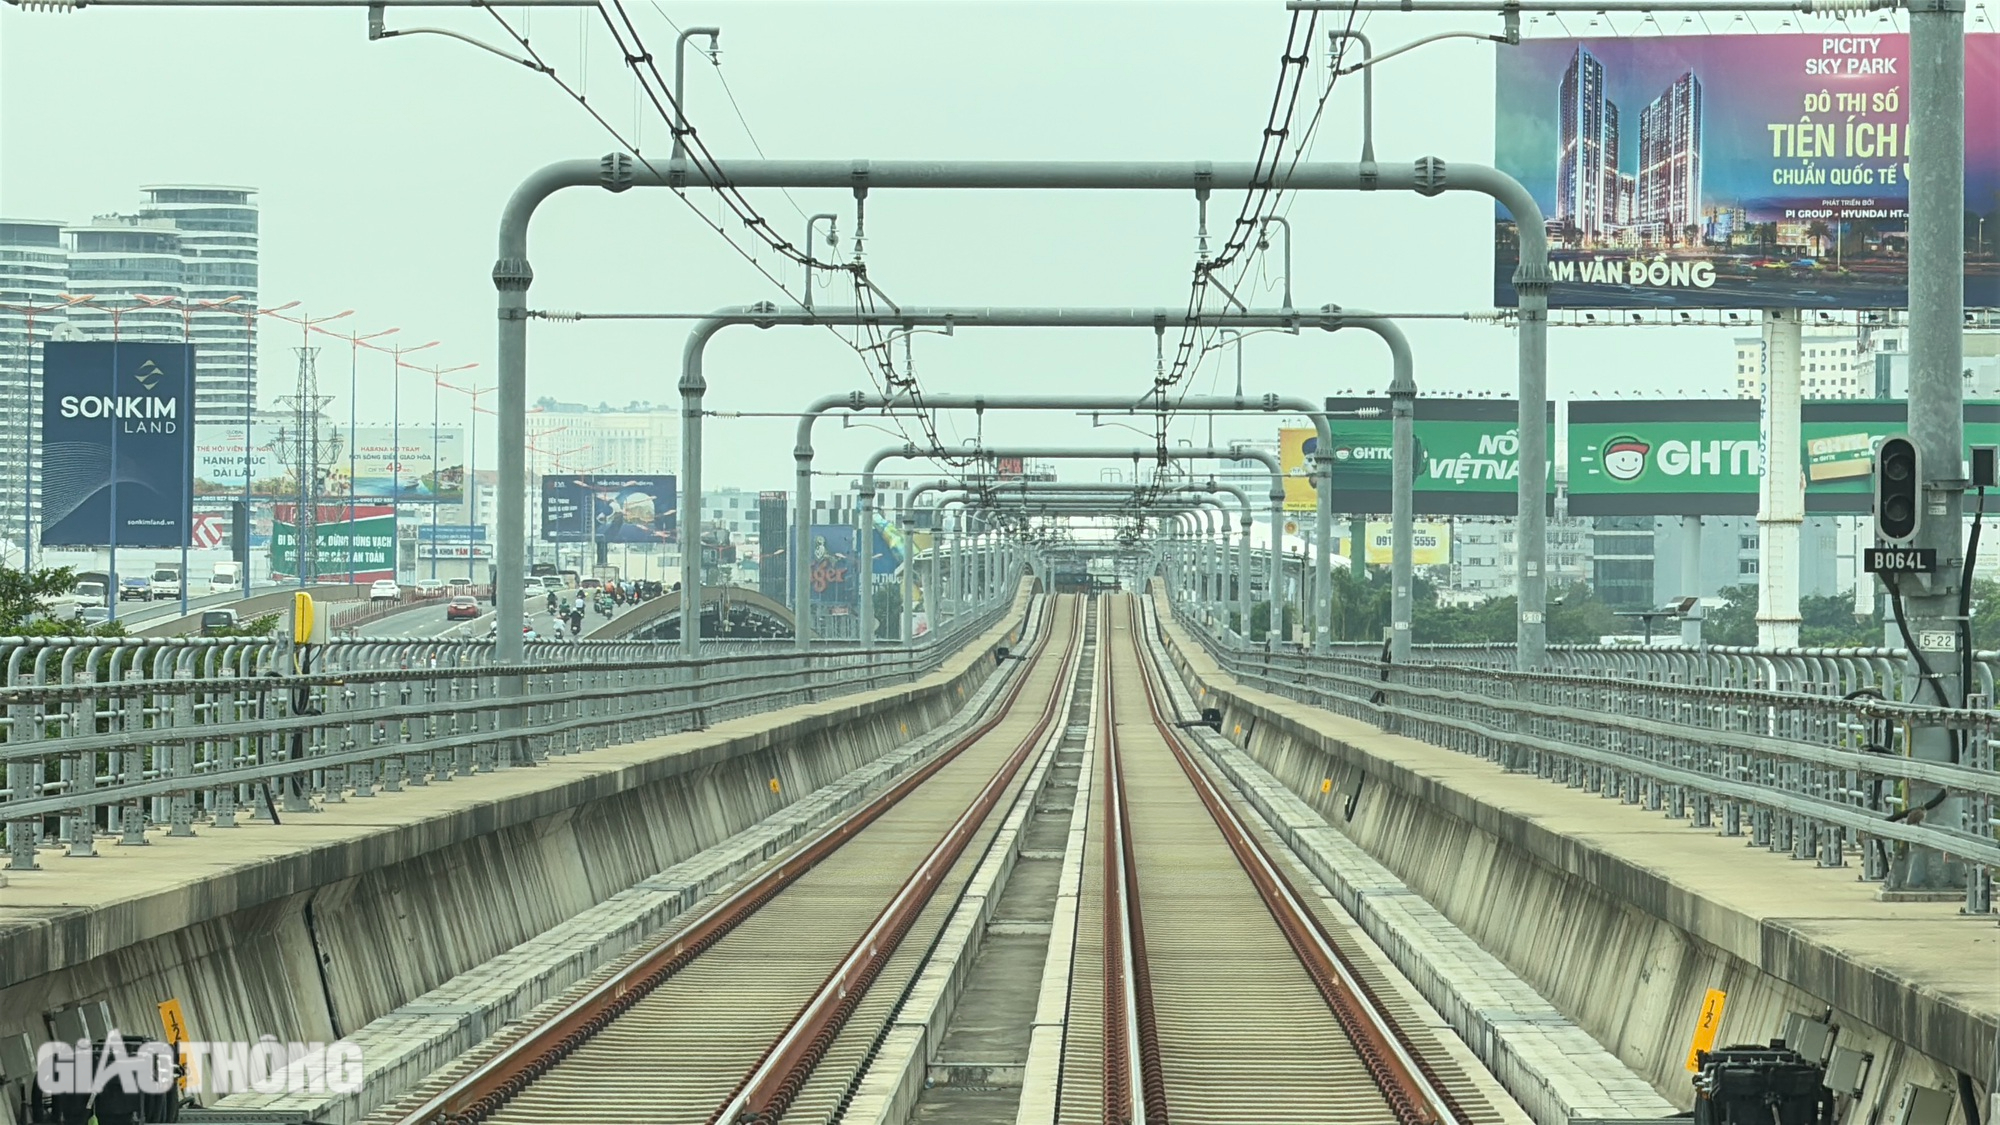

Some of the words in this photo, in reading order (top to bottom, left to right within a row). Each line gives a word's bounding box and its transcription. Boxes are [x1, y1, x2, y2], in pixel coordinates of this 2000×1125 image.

[1822, 38, 1881, 54] PICITY
[1805, 58, 1842, 75] SKY
[1847, 58, 1897, 74] PARK
[1804, 89, 1831, 113] ĐÔ
[1836, 93, 1867, 116] THỊ
[1872, 86, 1900, 113] SỐ
[1767, 115, 1835, 165] TIỆN
[1845, 115, 1897, 157] ÍCH
[1772, 162, 1826, 184] CHUẨN
[1830, 163, 1874, 186] QUỐC
[1878, 163, 1898, 184] TẾ
[1785, 209, 1795, 218] PI
[1798, 209, 1833, 218] GROUP
[1841, 209, 1887, 218] HYUNDAI
[1579, 256, 1623, 283] VĂN
[1628, 252, 1717, 288] ĐỒNG
[60, 396, 176, 419] SONKIM
[125, 421, 176, 434] LAND
[372, 536, 392, 549] VẠCH
[1874, 552, 1926, 569] B064L
[1923, 635, 1951, 647] 5-22
